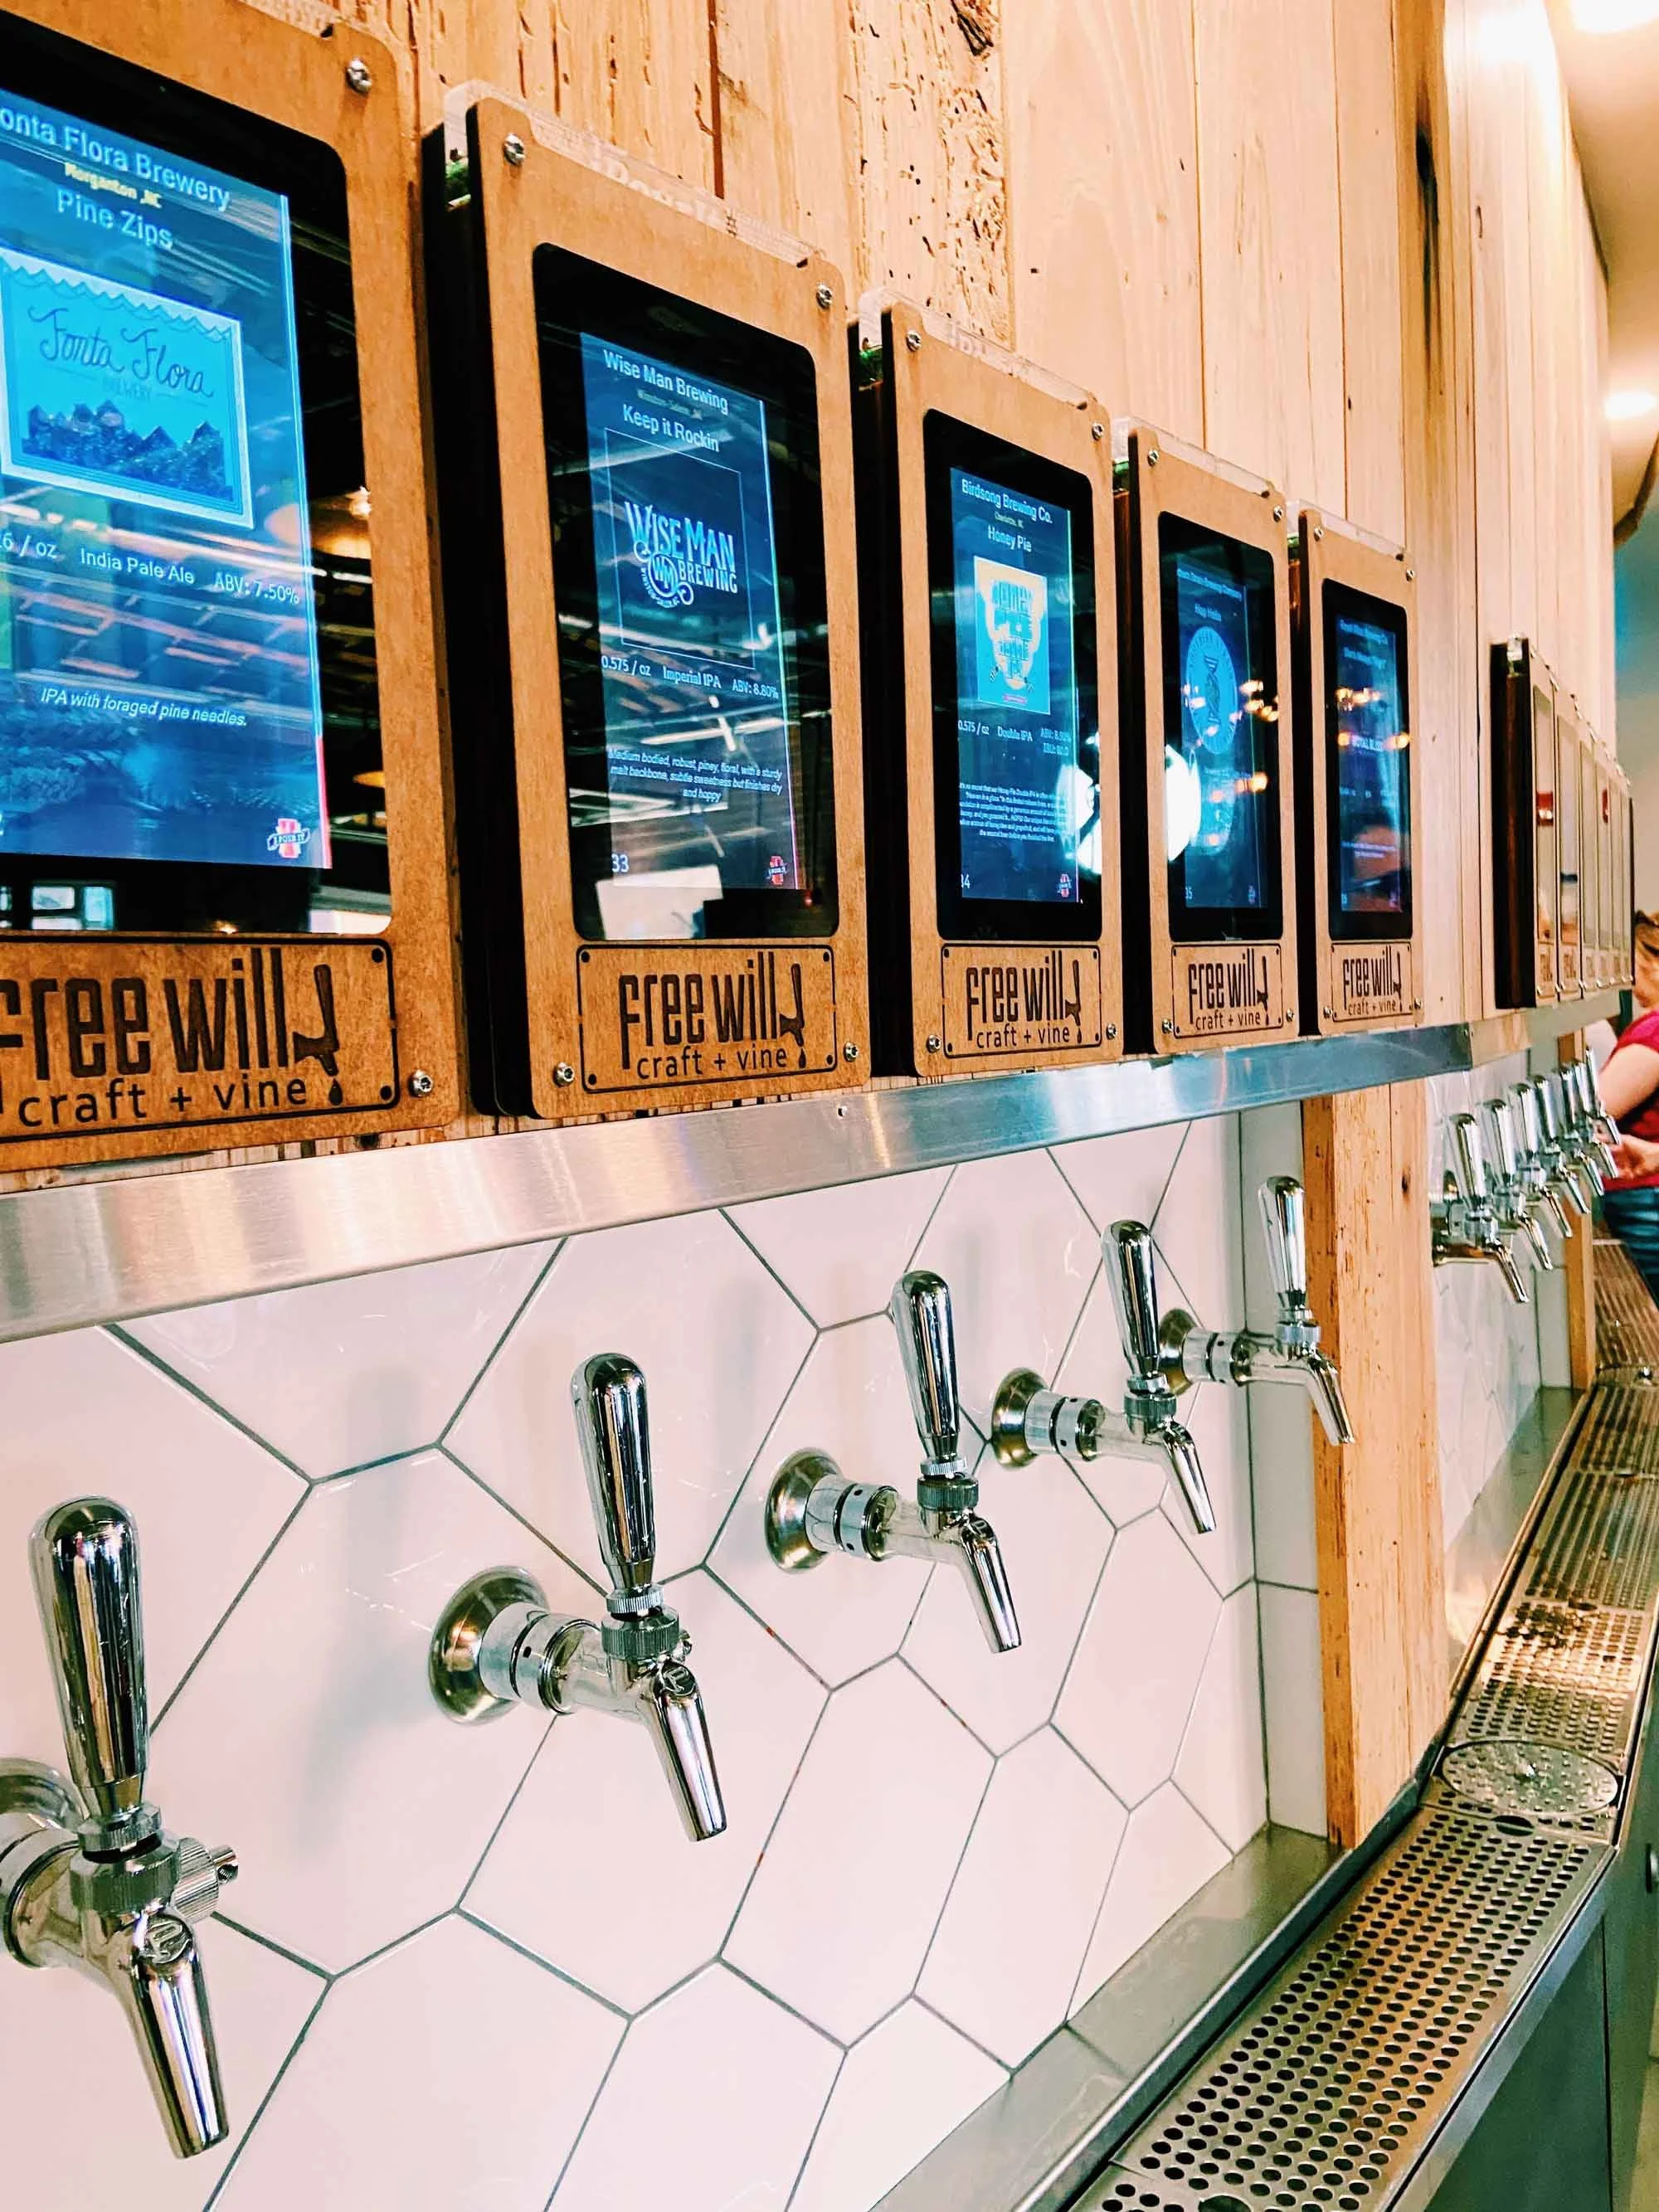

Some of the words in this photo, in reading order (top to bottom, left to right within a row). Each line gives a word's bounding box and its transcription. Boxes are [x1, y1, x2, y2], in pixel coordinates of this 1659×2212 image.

[0, 107, 56, 145] onta
[64, 126, 129, 172] Flora
[135, 153, 231, 211] Brewery
[57, 188, 114, 228] Pine
[120, 210, 173, 250] Zips
[27, 305, 124, 372] Fonta
[120, 328, 214, 398] Flora
[603, 349, 640, 379] Wise
[644, 364, 674, 391] Man
[676, 377, 728, 415] Brewing
[623, 404, 659, 435] Keep
[662, 417, 673, 436] it
[674, 421, 719, 453] Rockin
[962, 479, 1001, 508] Birdsong
[1003, 493, 1037, 522] Brewing
[1038, 506, 1053, 524] Co.
[624, 501, 684, 560] WISE
[684, 517, 736, 573] MAN
[988, 524, 1015, 550] Honey
[1017, 534, 1032, 552] Pie
[20, 534, 31, 557] /
[36, 542, 57, 559] oz
[80, 547, 122, 571] India
[127, 557, 163, 579] Pale
[168, 565, 195, 584] Ale
[215, 571, 249, 595] ABV:
[253, 581, 299, 604] 7.50%
[677, 559, 737, 594] BREWING
[601, 655, 628, 673] 0.575
[631, 660, 638, 676] /
[640, 664, 651, 676] oz
[663, 666, 701, 684] Imperial
[703, 673, 722, 688] IPA
[732, 678, 752, 693] ABV:
[41, 688, 66, 705] IPA
[71, 693, 100, 708] with
[103, 695, 159, 717] foraged
[159, 705, 189, 720] pine
[192, 710, 247, 727] needles.
[997, 726, 1020, 739] Double
[1021, 730, 1033, 741] IPA
[608, 748, 640, 762] Medium
[642, 751, 671, 767] bodied,
[761, 767, 783, 781] sturdy
[611, 765, 628, 775] malt
[669, 772, 693, 784] subtle
[693, 775, 731, 787] sweetness
[732, 777, 745, 789] but
[771, 783, 782, 796] dry
[683, 788, 698, 798] and
[698, 789, 722, 803] hoppy
[611, 853, 630, 873] 33
[966, 967, 1019, 1041] free
[1022, 950, 1063, 1022] will
[1188, 963, 1224, 1023] free
[1227, 948, 1258, 1007] will
[1342, 958, 1369, 1010] free
[1372, 946, 1393, 995] will
[163, 948, 289, 1074] will
[619, 974, 704, 1069] free
[711, 951, 777, 1043] will
[1194, 1009, 1224, 1030] craft
[1228, 1016, 1233, 1025] +
[1238, 1009, 1261, 1027] vine
[1347, 998, 1369, 1016] craft
[1379, 996, 1396, 1013] vine
[976, 1023, 1017, 1048] craft
[1024, 1032, 1031, 1042] +
[1039, 1023, 1070, 1043] vine
[637, 1046, 703, 1079] craft
[713, 1053, 727, 1071] +
[737, 1043, 786, 1070] vine
[18, 1078, 146, 1126] craft
[170, 1087, 192, 1112] +
[213, 1073, 307, 1110] vine
